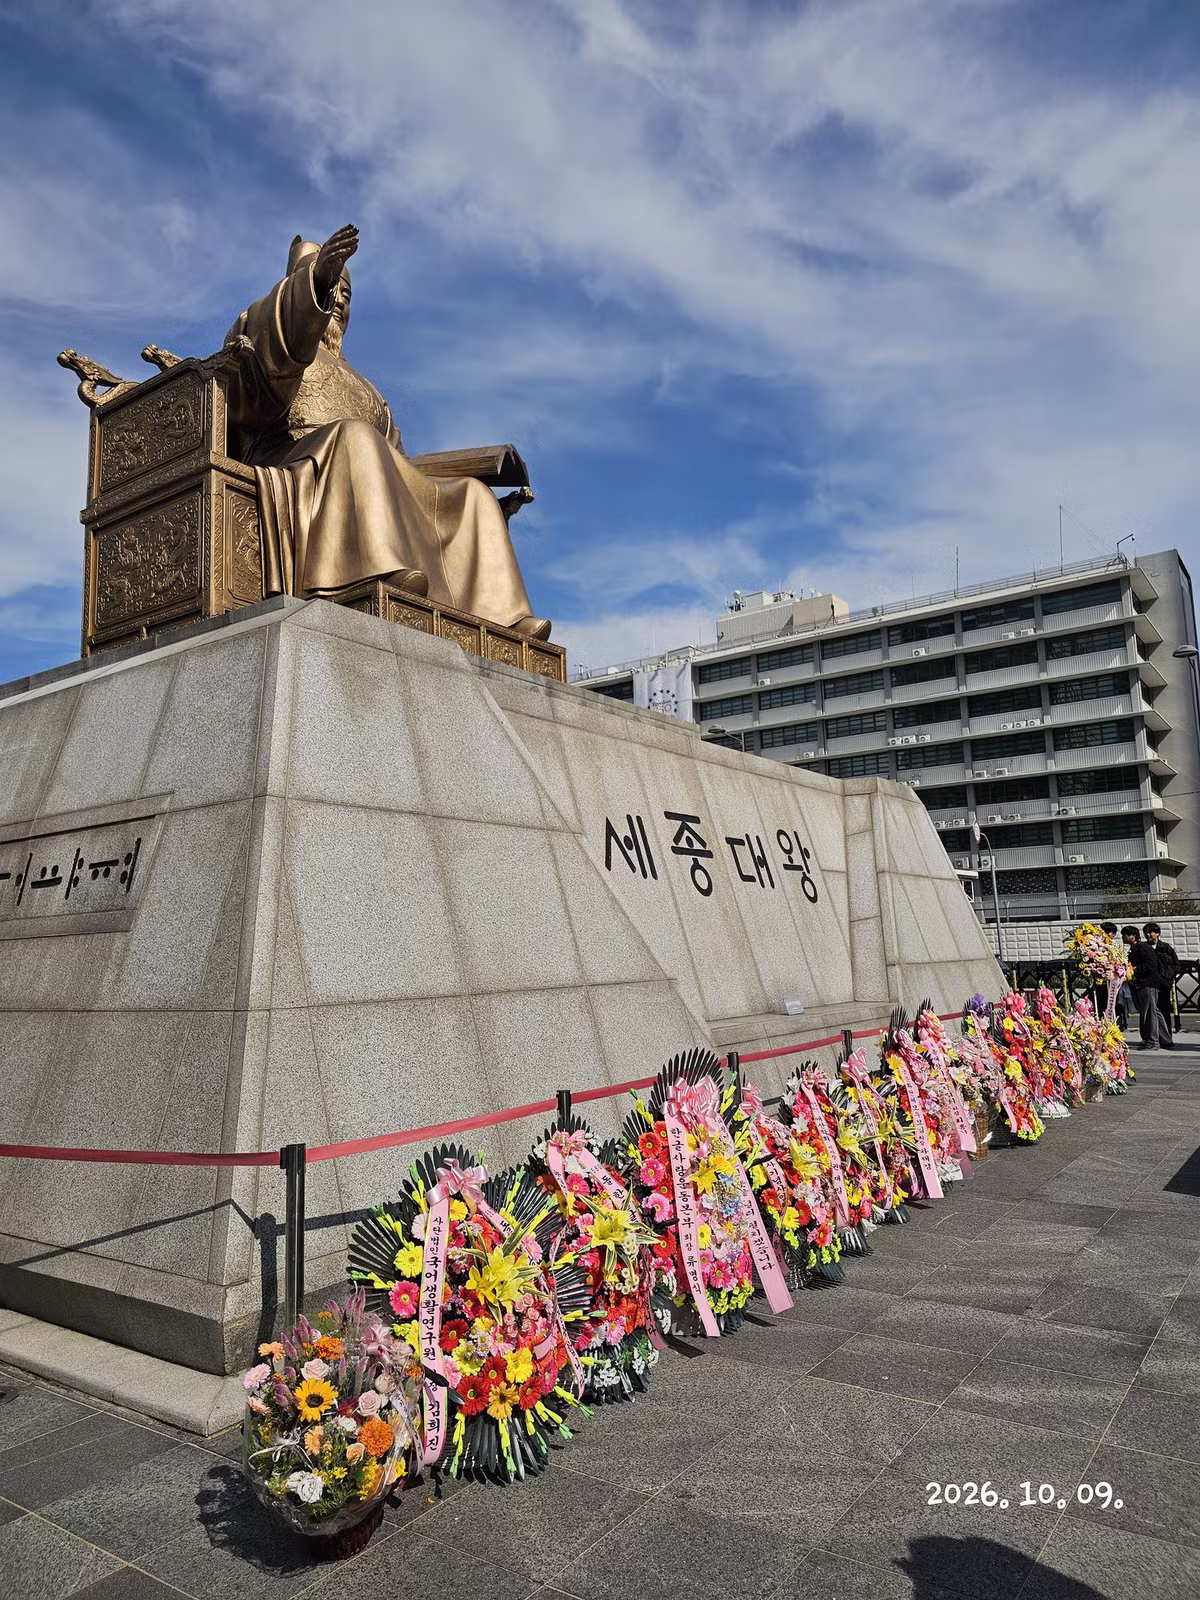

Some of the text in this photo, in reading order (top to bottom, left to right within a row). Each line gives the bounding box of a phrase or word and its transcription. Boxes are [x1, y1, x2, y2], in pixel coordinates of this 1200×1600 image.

[604, 810, 818, 904] 세종대왕
[430, 1216, 444, 1256] 사단법인
[669, 1126, 695, 1229] 한글사랑운동본부
[684, 1232, 692, 1252] 회장
[420, 1256, 442, 1361] 국어생활연구원
[426, 1400, 440, 1451] 김희진
